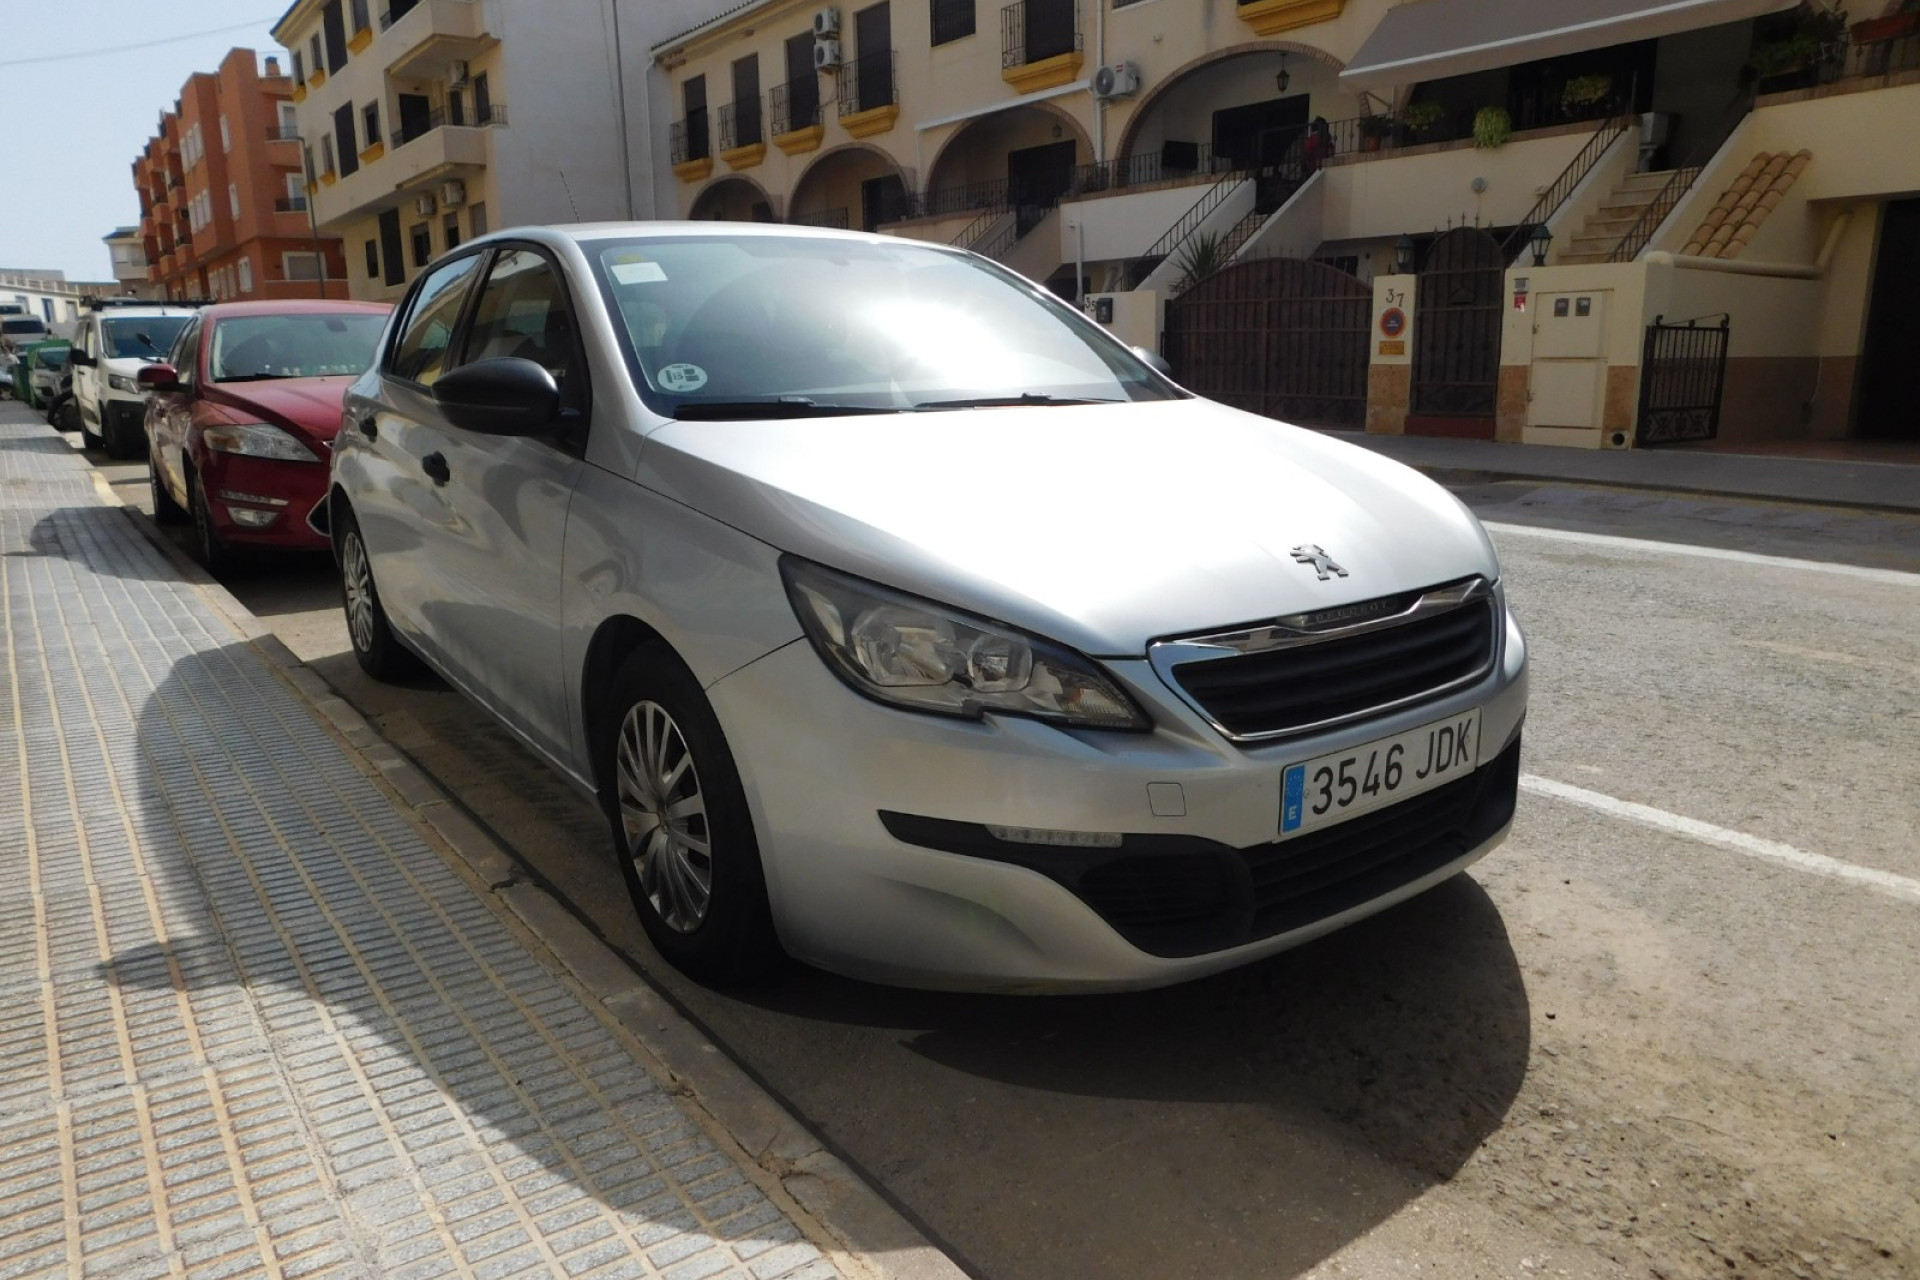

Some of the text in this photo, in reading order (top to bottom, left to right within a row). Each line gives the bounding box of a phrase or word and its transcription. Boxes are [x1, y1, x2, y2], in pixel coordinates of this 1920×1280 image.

[1386, 288, 1405, 307] 37
[1312, 718, 1472, 815] 3546 JDK
[1288, 805, 1297, 820] E
